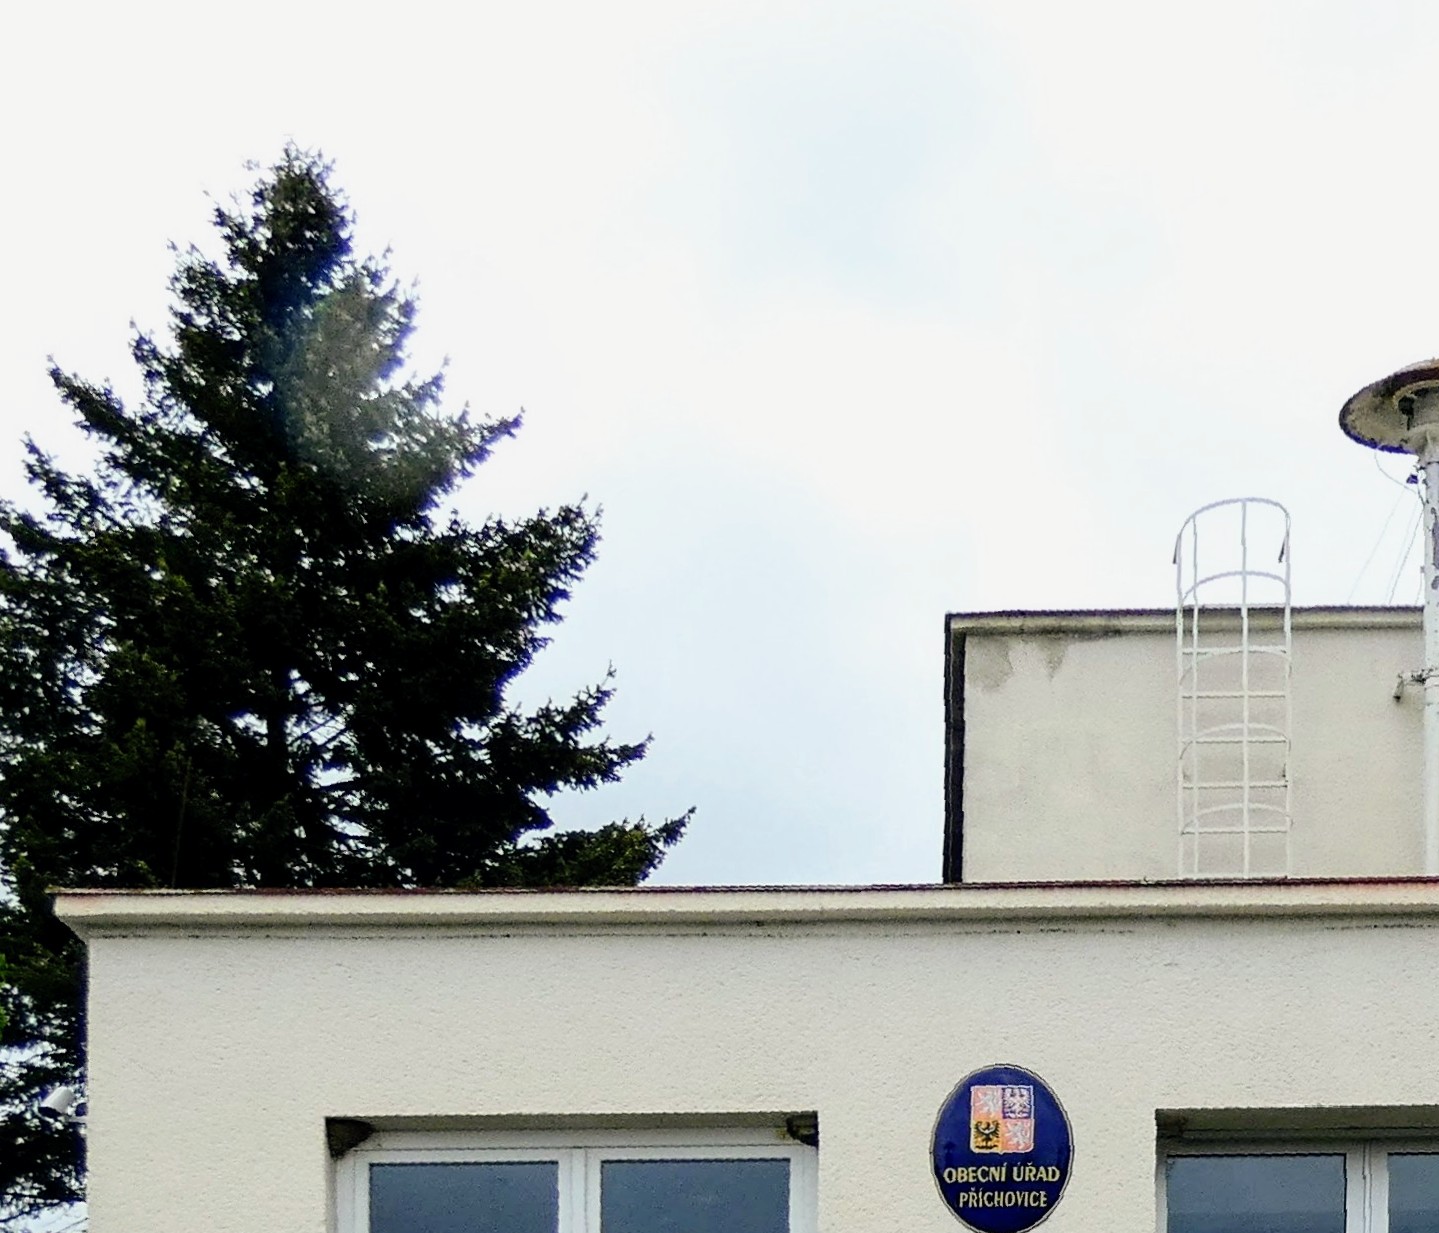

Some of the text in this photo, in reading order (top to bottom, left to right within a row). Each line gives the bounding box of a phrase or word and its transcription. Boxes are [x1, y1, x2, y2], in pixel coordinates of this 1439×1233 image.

[943, 1161, 1060, 1183] OBECNÍ ÚŘAD
[959, 1187, 1048, 1208] PŘÍCHOVICE
